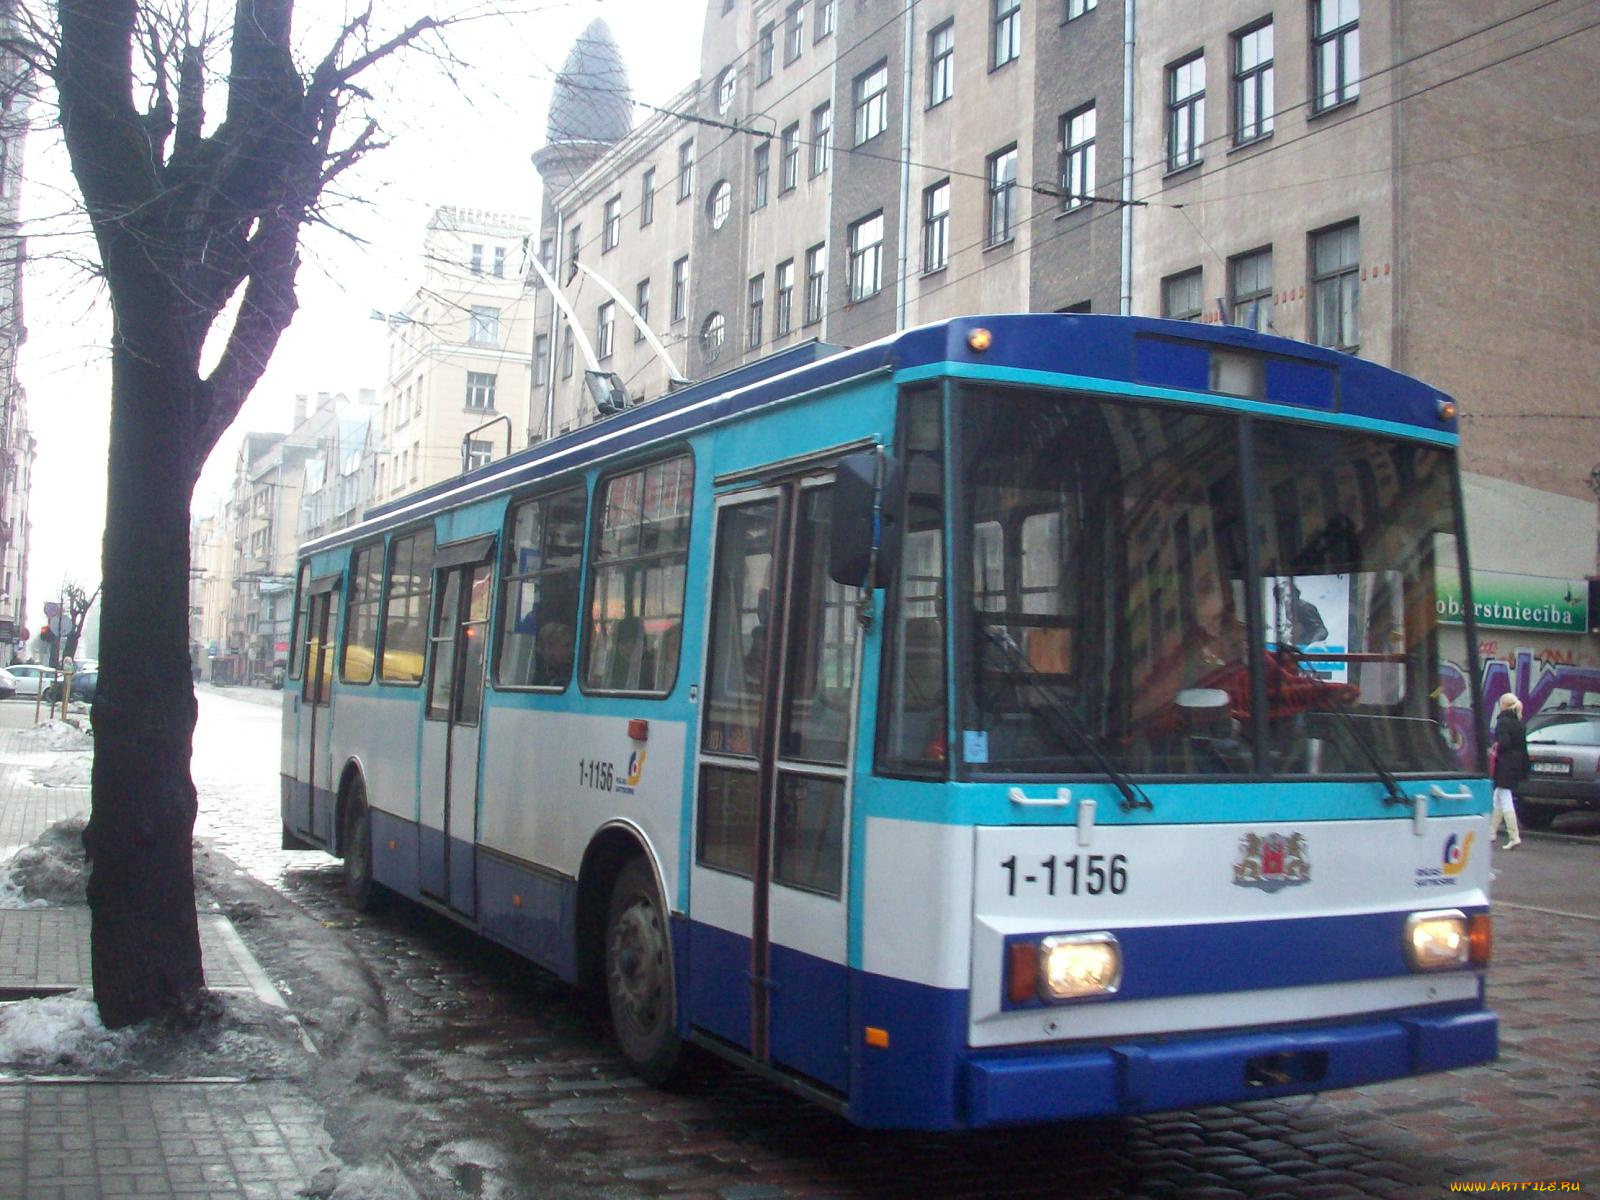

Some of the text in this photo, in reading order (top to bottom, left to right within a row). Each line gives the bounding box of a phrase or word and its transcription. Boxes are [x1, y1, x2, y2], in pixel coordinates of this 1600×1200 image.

[1436, 594, 1573, 624] obrstniecība
[579, 758, 614, 792] 1-1156
[1001, 854, 1128, 896] 1-1156
